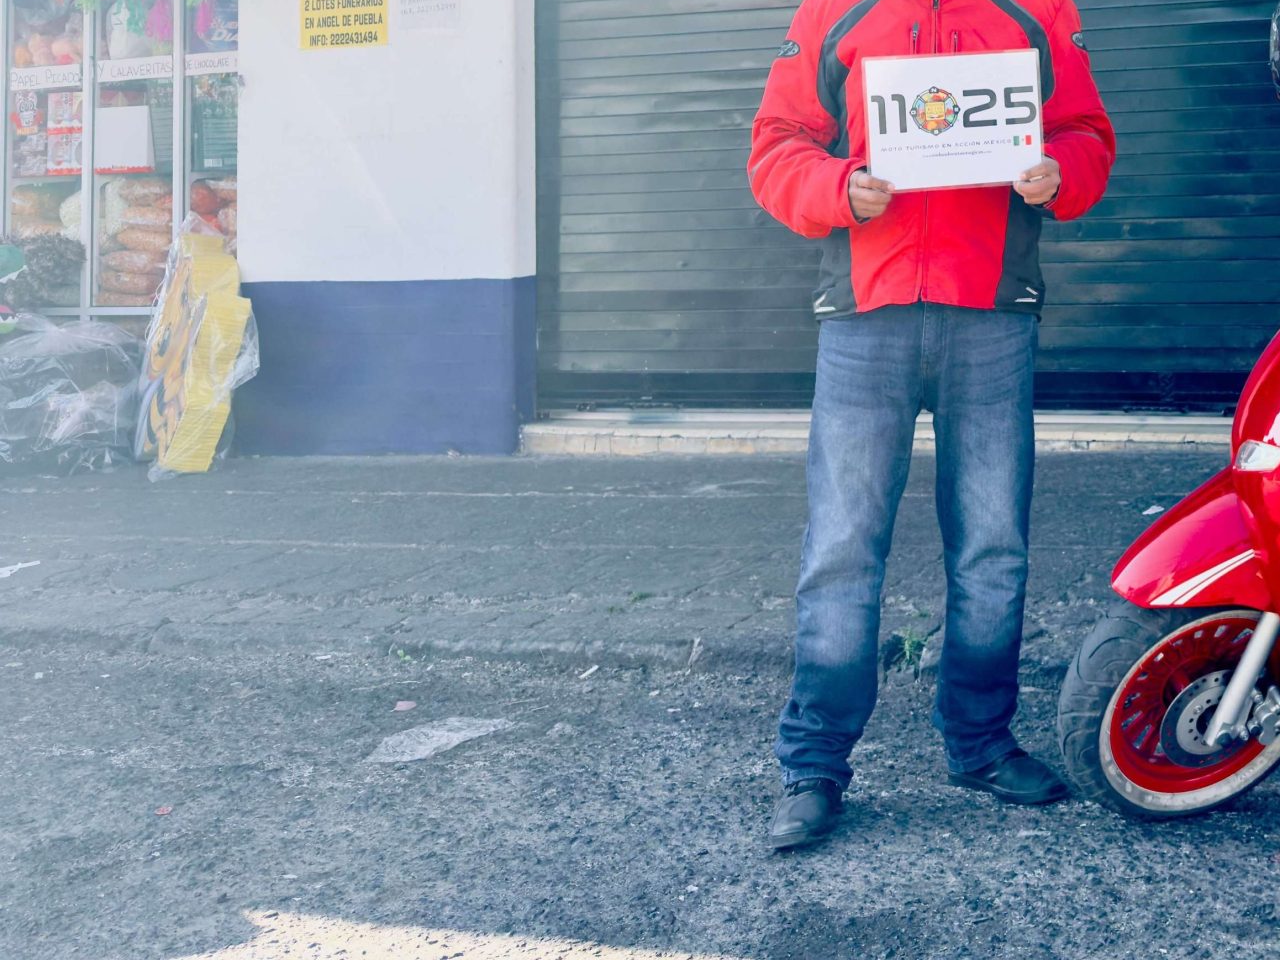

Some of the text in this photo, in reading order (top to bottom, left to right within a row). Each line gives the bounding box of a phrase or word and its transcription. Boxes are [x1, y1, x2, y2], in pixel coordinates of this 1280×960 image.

[304, 0, 310, 11] 2
[305, 12, 384, 29] EN ANGEL DE PUEBLA
[309, 30, 378, 47] INFO: 2222431494
[10, 71, 41, 88] PAPEL
[110, 61, 173, 79] CALAVERITAS
